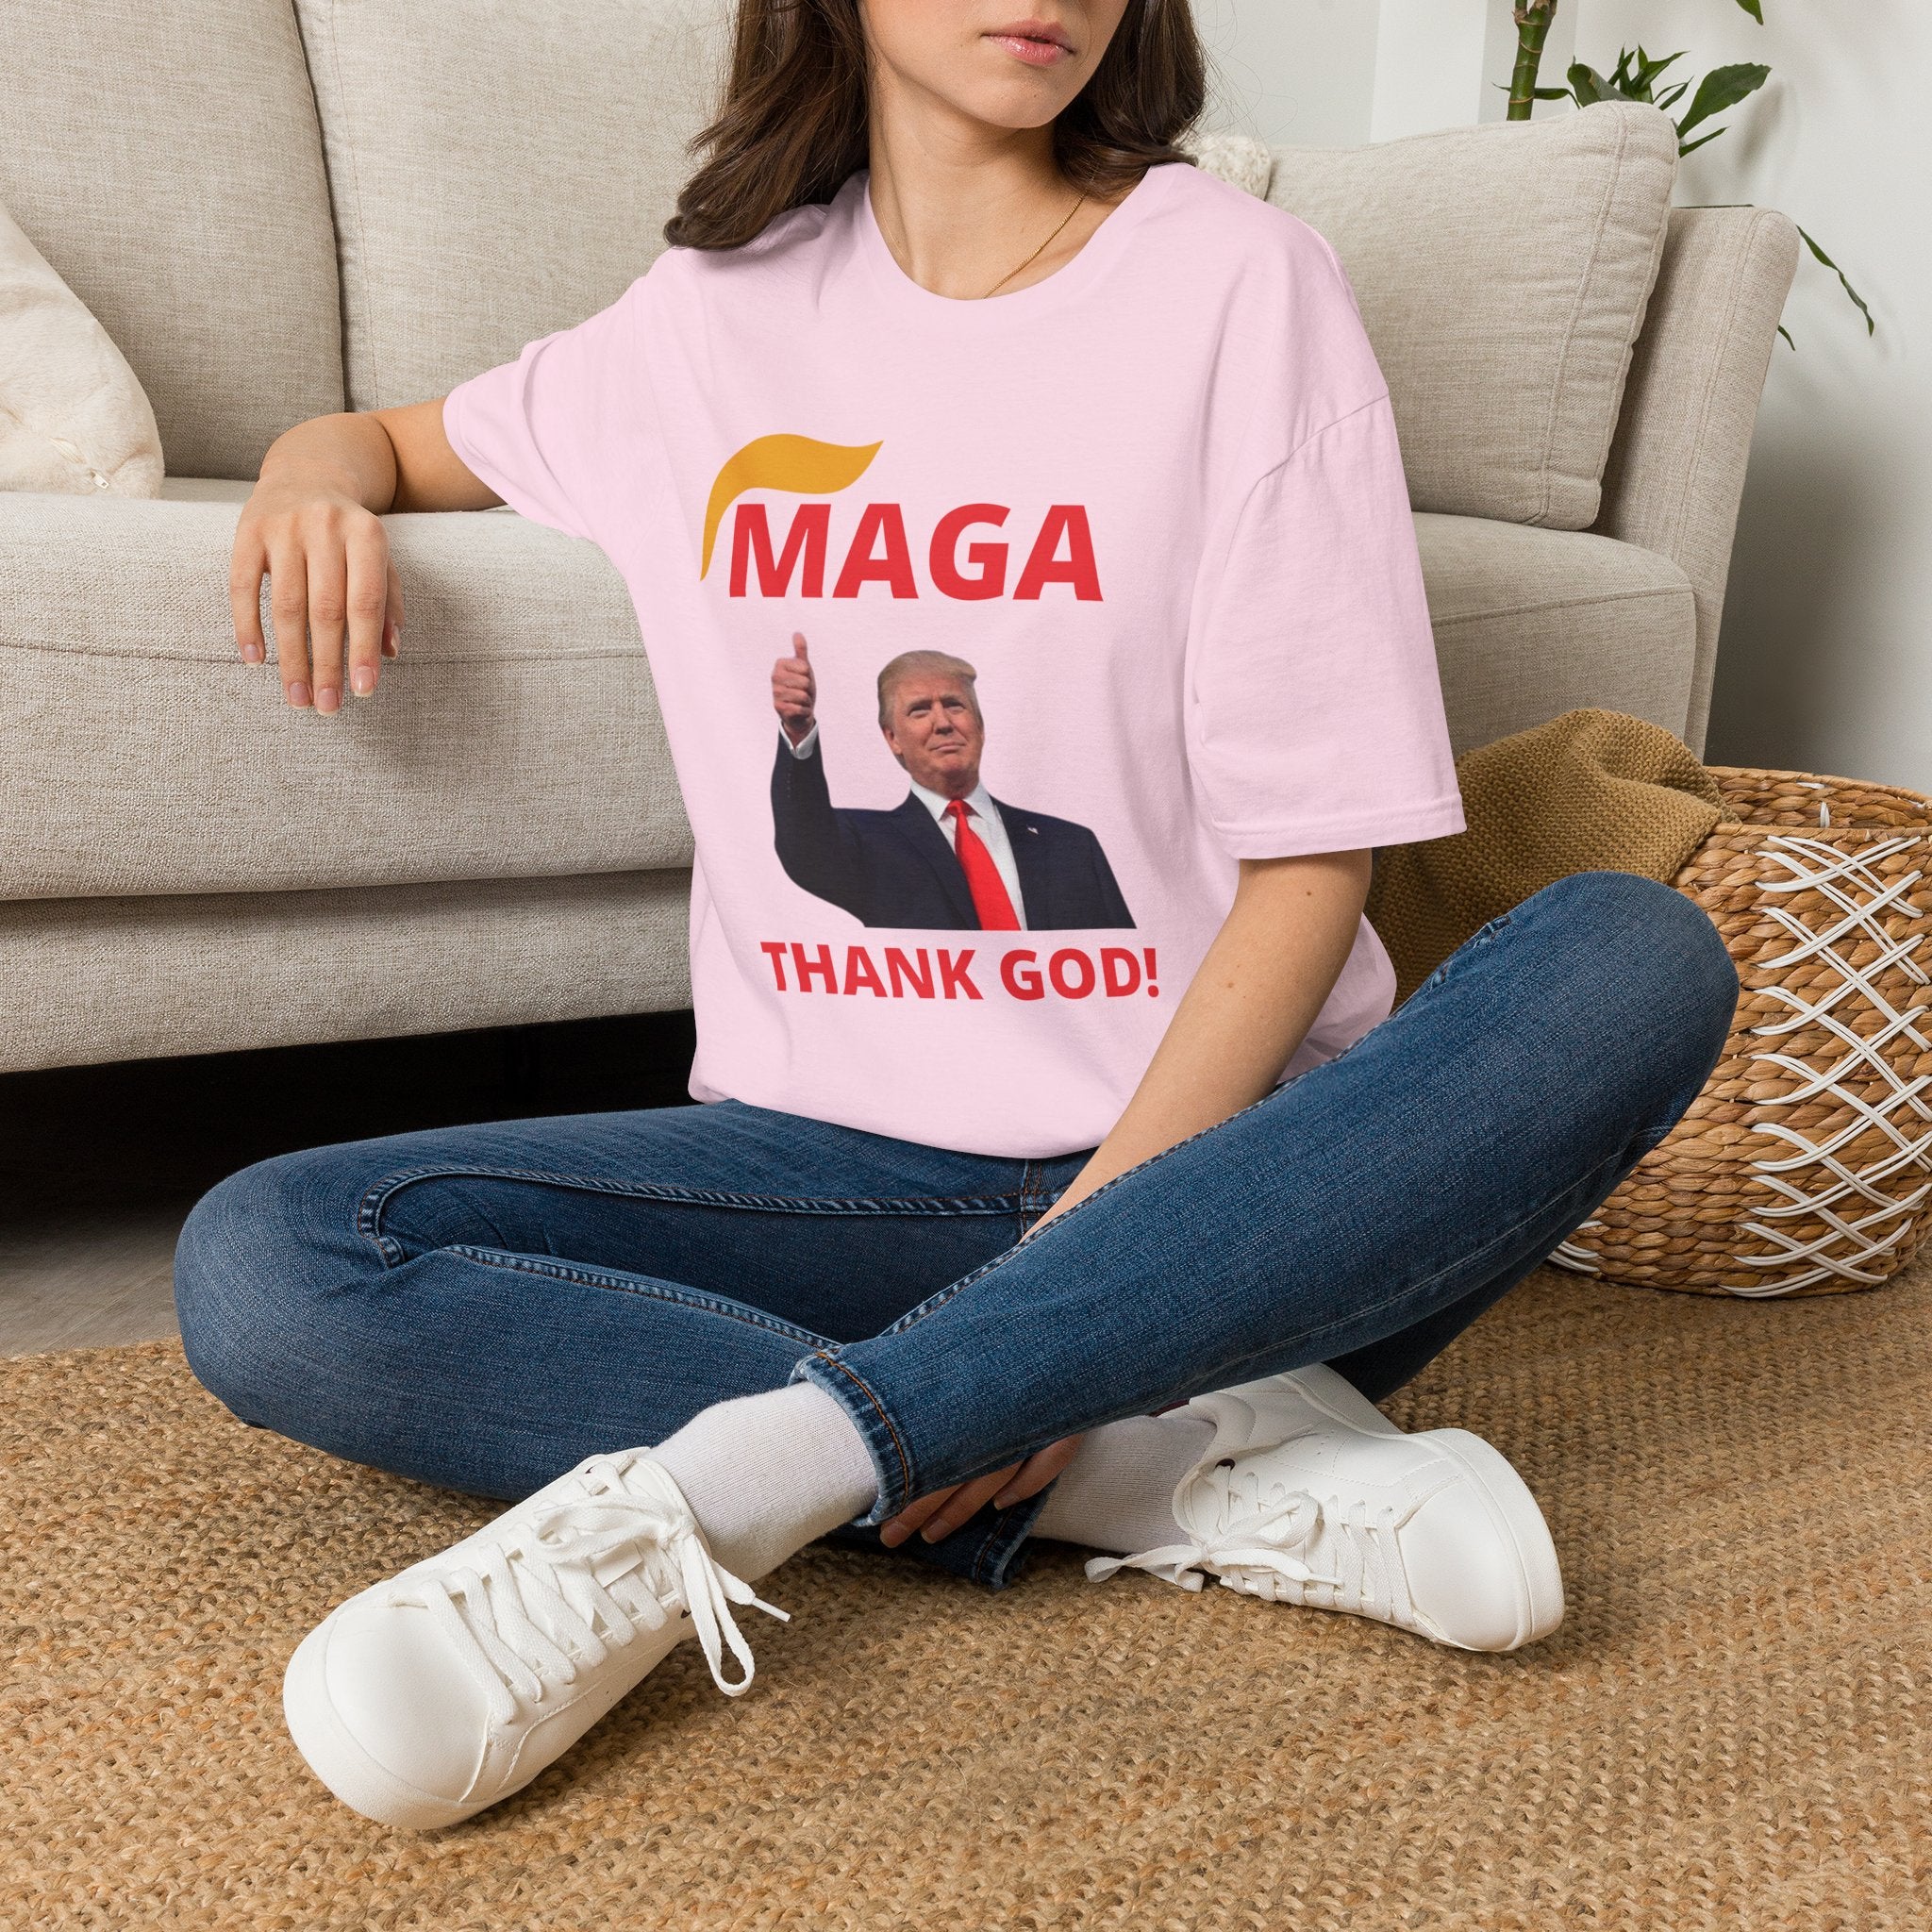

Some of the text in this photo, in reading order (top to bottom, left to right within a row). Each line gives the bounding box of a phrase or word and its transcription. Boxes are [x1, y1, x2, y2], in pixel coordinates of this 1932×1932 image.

[729, 503, 1104, 602] MAGA
[760, 941, 1159, 1002] THANK GOD!
